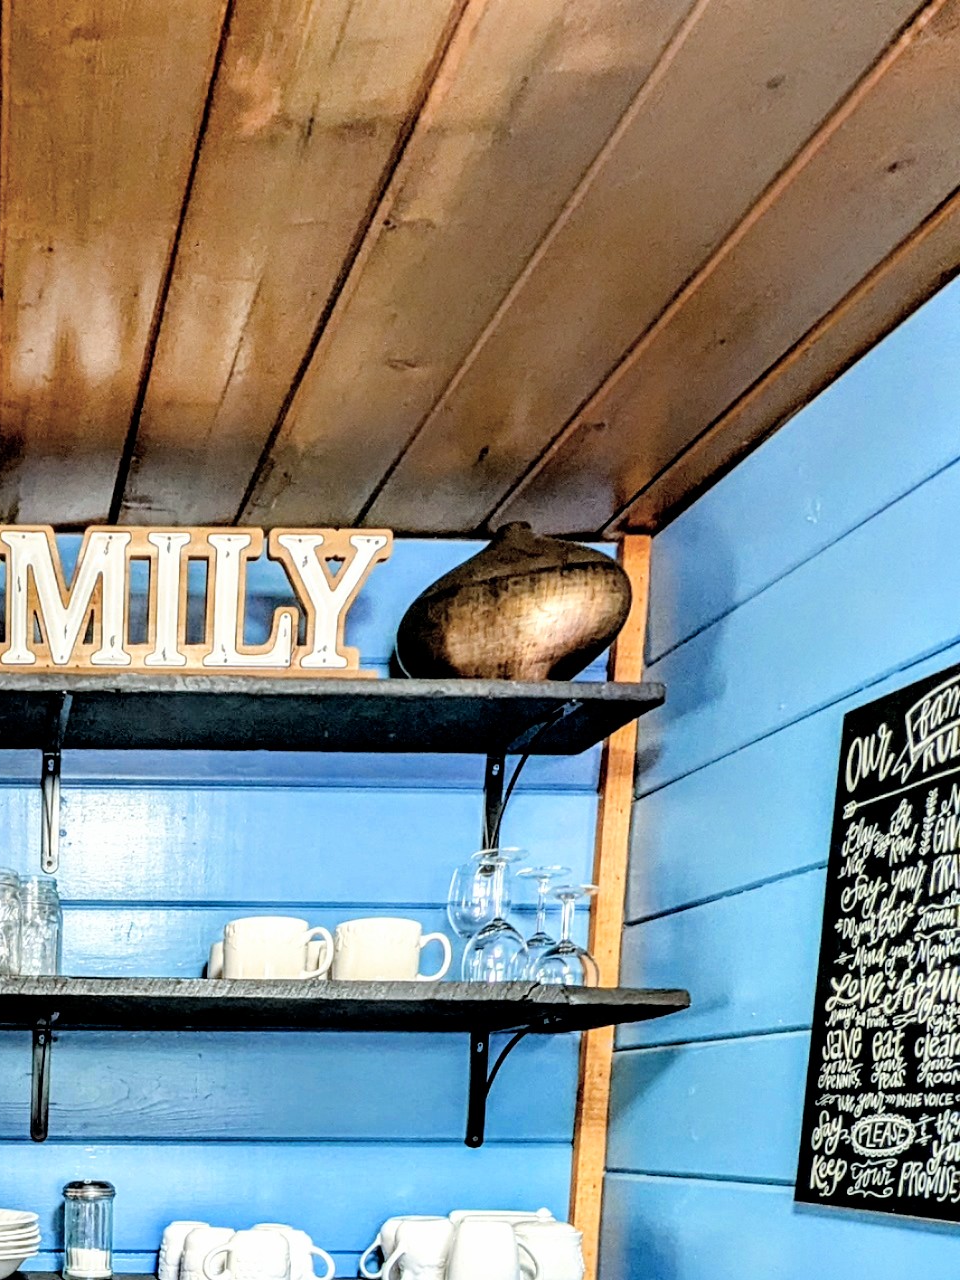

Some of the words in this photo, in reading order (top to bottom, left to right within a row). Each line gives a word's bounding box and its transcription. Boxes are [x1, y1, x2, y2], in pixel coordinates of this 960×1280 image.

[845, 723, 896, 793] Our
[841, 817, 879, 859] Play
[841, 875, 888, 919] Say
[885, 859, 928, 908] your
[848, 938, 887, 977] Mind
[884, 939, 915, 976] your
[872, 1028, 905, 1061] eat
[818, 1057, 864, 1088] your
[871, 1056, 908, 1083] your
[916, 1056, 960, 1083] your
[853, 1091, 887, 1118] your
[895, 1093, 923, 1108] INSIDE
[923, 1092, 954, 1106] VOICE
[811, 1110, 844, 1155] Say
[858, 1121, 909, 1148] PLEASE
[809, 1154, 847, 1197] Keep
[851, 1166, 895, 1190] your
